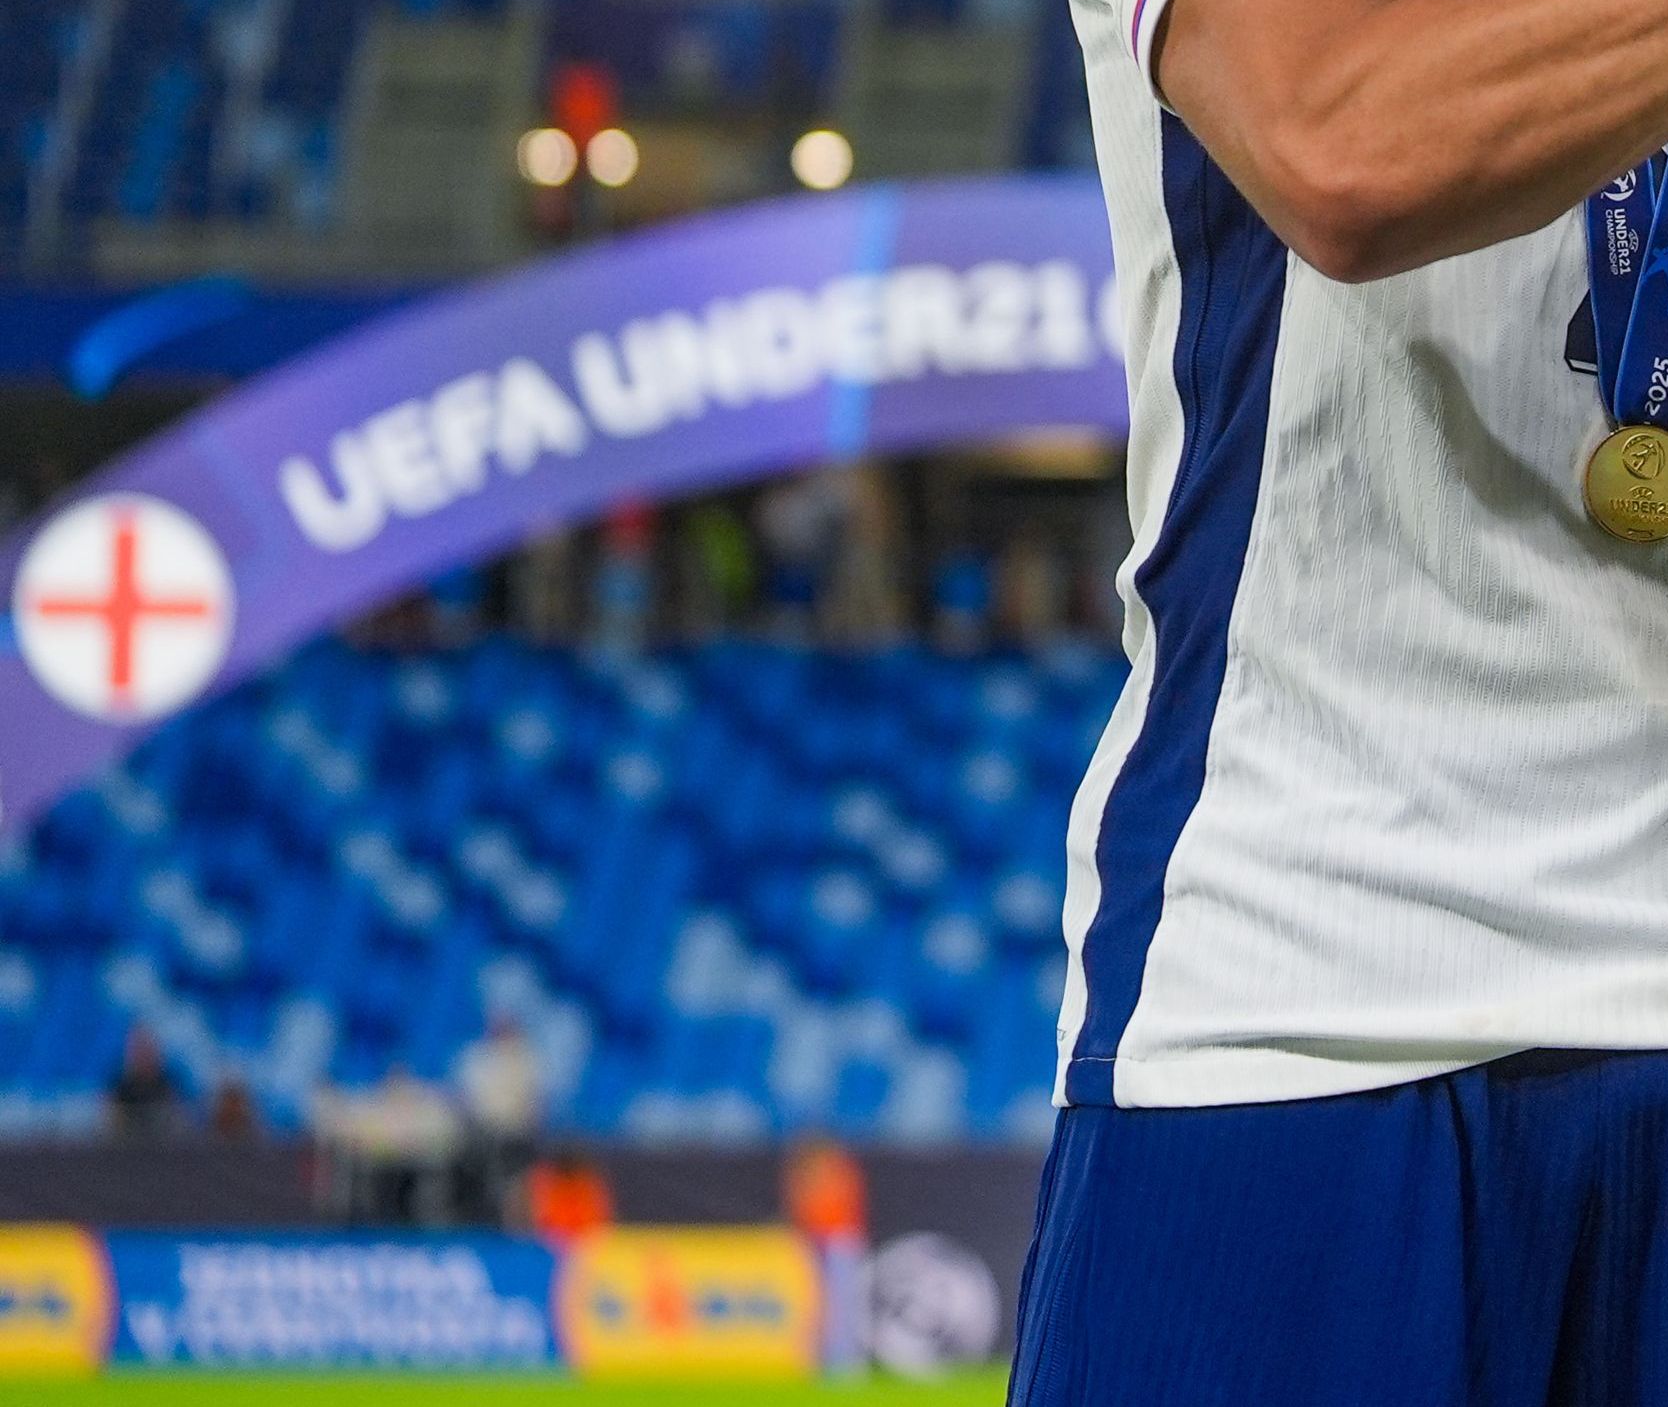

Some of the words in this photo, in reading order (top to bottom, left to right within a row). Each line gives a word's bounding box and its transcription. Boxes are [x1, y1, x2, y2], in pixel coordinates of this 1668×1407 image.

[1605, 209, 1618, 276] CHAMPIONSHIP
[1614, 208, 1631, 275] UNDER21
[280, 358, 592, 555] UEFA
[569, 258, 1093, 441] UNDER21
